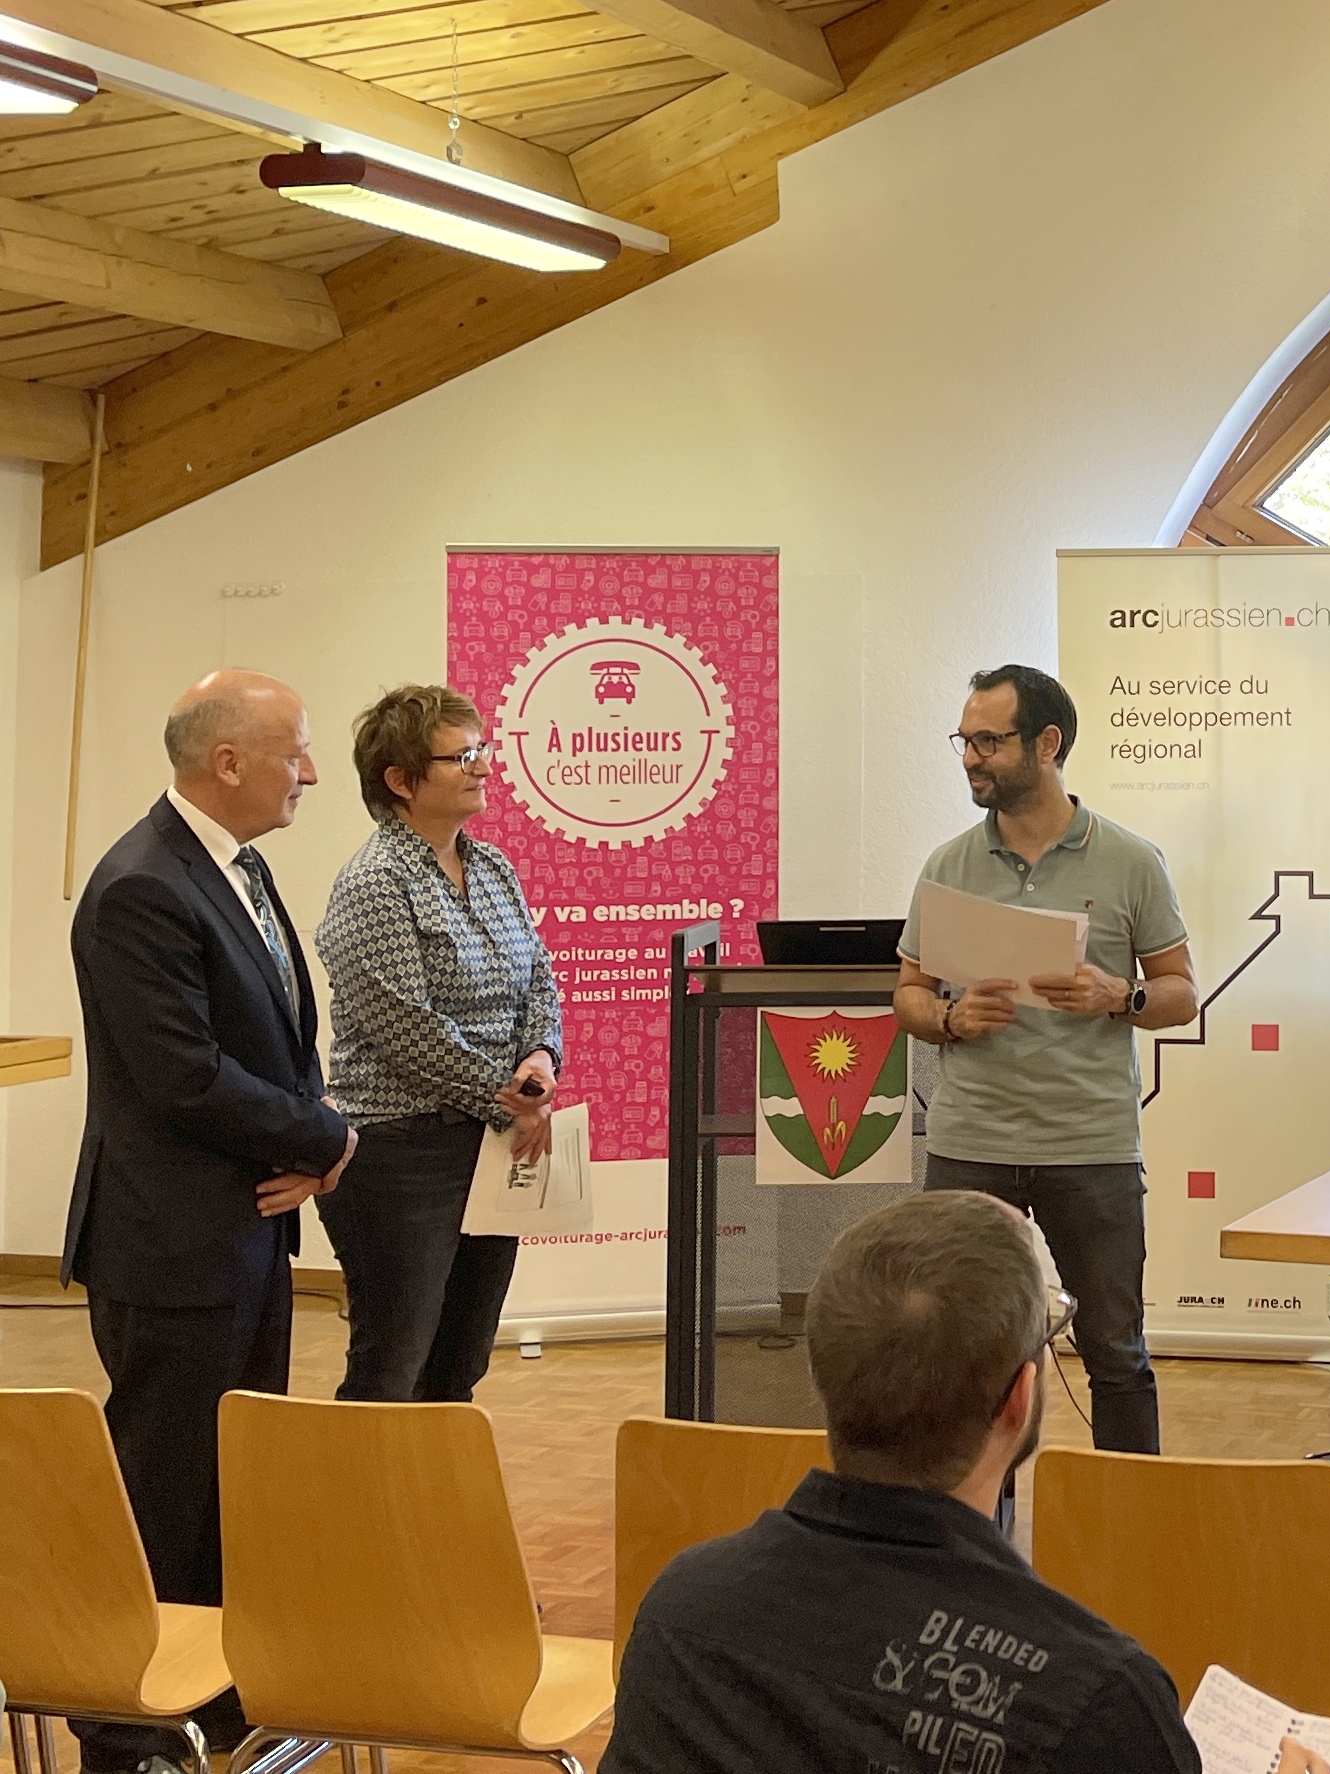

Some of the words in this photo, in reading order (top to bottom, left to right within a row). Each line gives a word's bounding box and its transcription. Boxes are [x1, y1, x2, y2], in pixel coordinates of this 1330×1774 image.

[1109, 601, 1330, 634] arcjurassien.ch
[1109, 675, 1141, 696] Au
[1149, 675, 1232, 696] service
[1239, 675, 1269, 695] du
[1110, 707, 1292, 732] développement
[547, 719, 562, 753] À
[572, 726, 682, 757] plusieurs
[1110, 739, 1202, 764] régional
[546, 759, 591, 786] c'est
[598, 758, 683, 785] meilleur
[1109, 780, 1210, 791] www.arcjurassien.ch
[554, 906, 587, 923] va
[593, 898, 724, 921] ensemble
[729, 898, 745, 918] ?
[547, 946, 638, 963] voiturage
[644, 947, 666, 959] au
[574, 965, 658, 984] jurassien
[571, 986, 616, 1002] aussi
[621, 985, 672, 1003] simpl
[919, 1609, 1050, 1673] BLENDED
